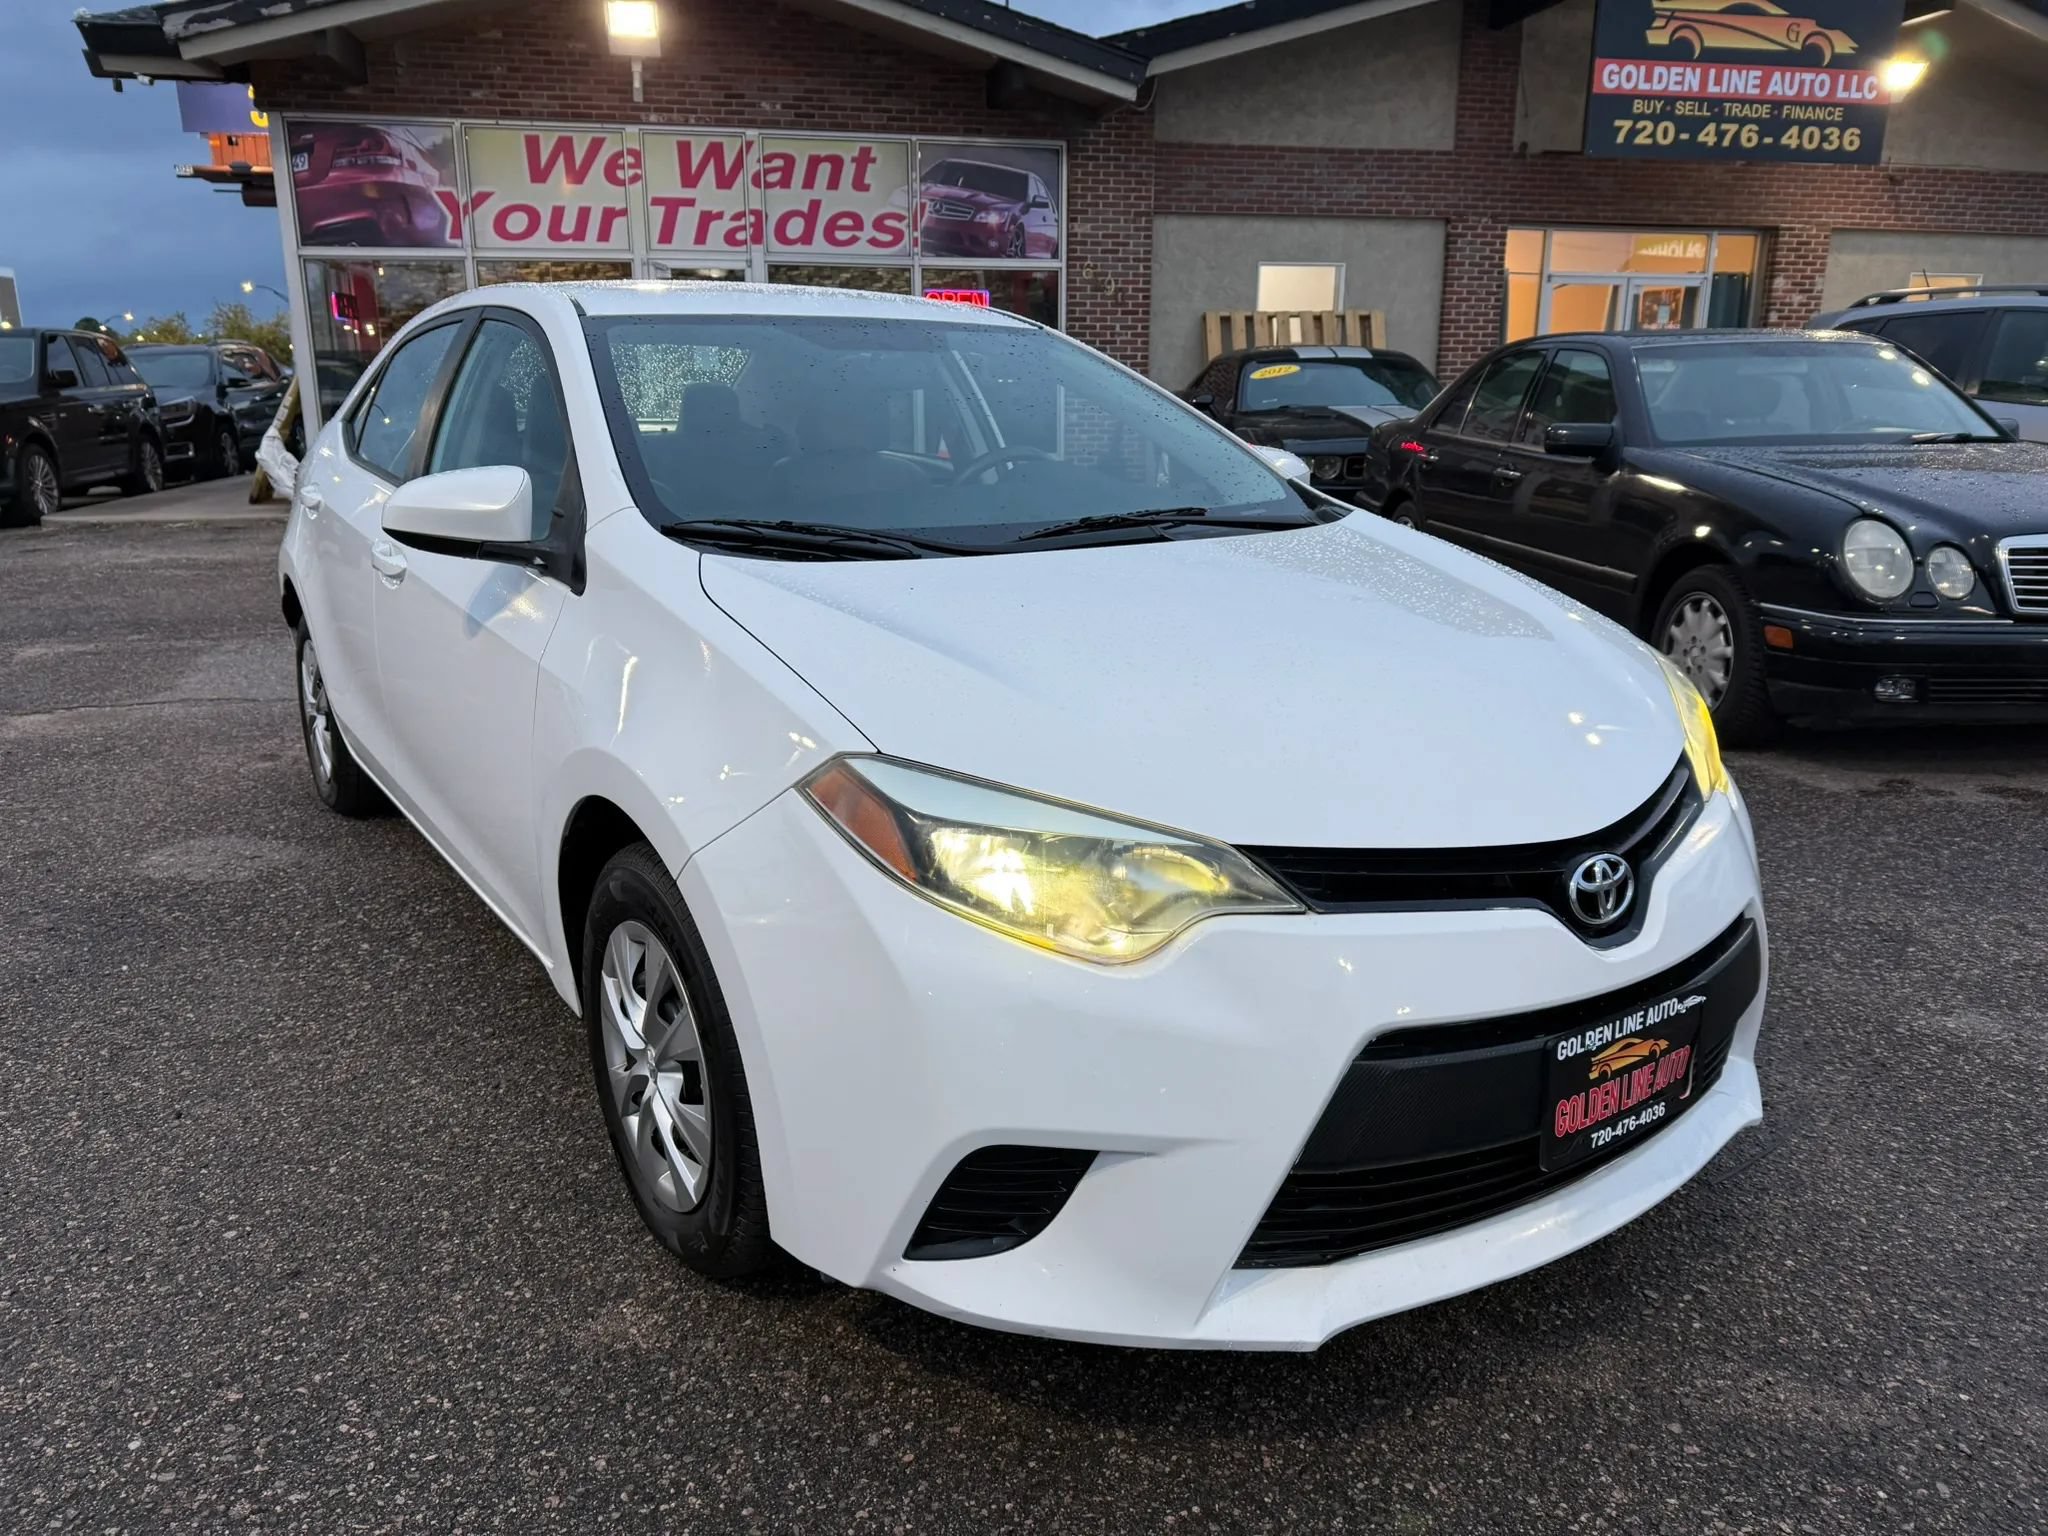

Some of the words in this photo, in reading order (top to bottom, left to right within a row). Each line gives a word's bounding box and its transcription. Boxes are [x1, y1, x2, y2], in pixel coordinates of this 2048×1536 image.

[1602, 63, 1701, 92] GOLDEN
[1707, 68, 1763, 95] LINE
[1766, 71, 1831, 98] AUTO
[1836, 74, 1878, 100] LLC
[1632, 99, 1664, 115] BUY
[1675, 101, 1711, 116] SELL
[1723, 103, 1771, 118] TRADE
[1782, 105, 1844, 121] FINANCE
[523, 134, 643, 187] We
[676, 140, 877, 193] Want
[434, 190, 629, 242] Your
[650, 197, 927, 249] Trades!
[1557, 1022, 1613, 1061] GOLDEN
[1615, 1011, 1645, 1039] LINE
[1646, 997, 1679, 1028] AUTO
[1555, 1078, 1621, 1138] GOLDEN
[1621, 1061, 1656, 1110] LINE
[1654, 1044, 1691, 1093] AUTO
[1591, 1101, 1666, 1149] 720-476-4036
